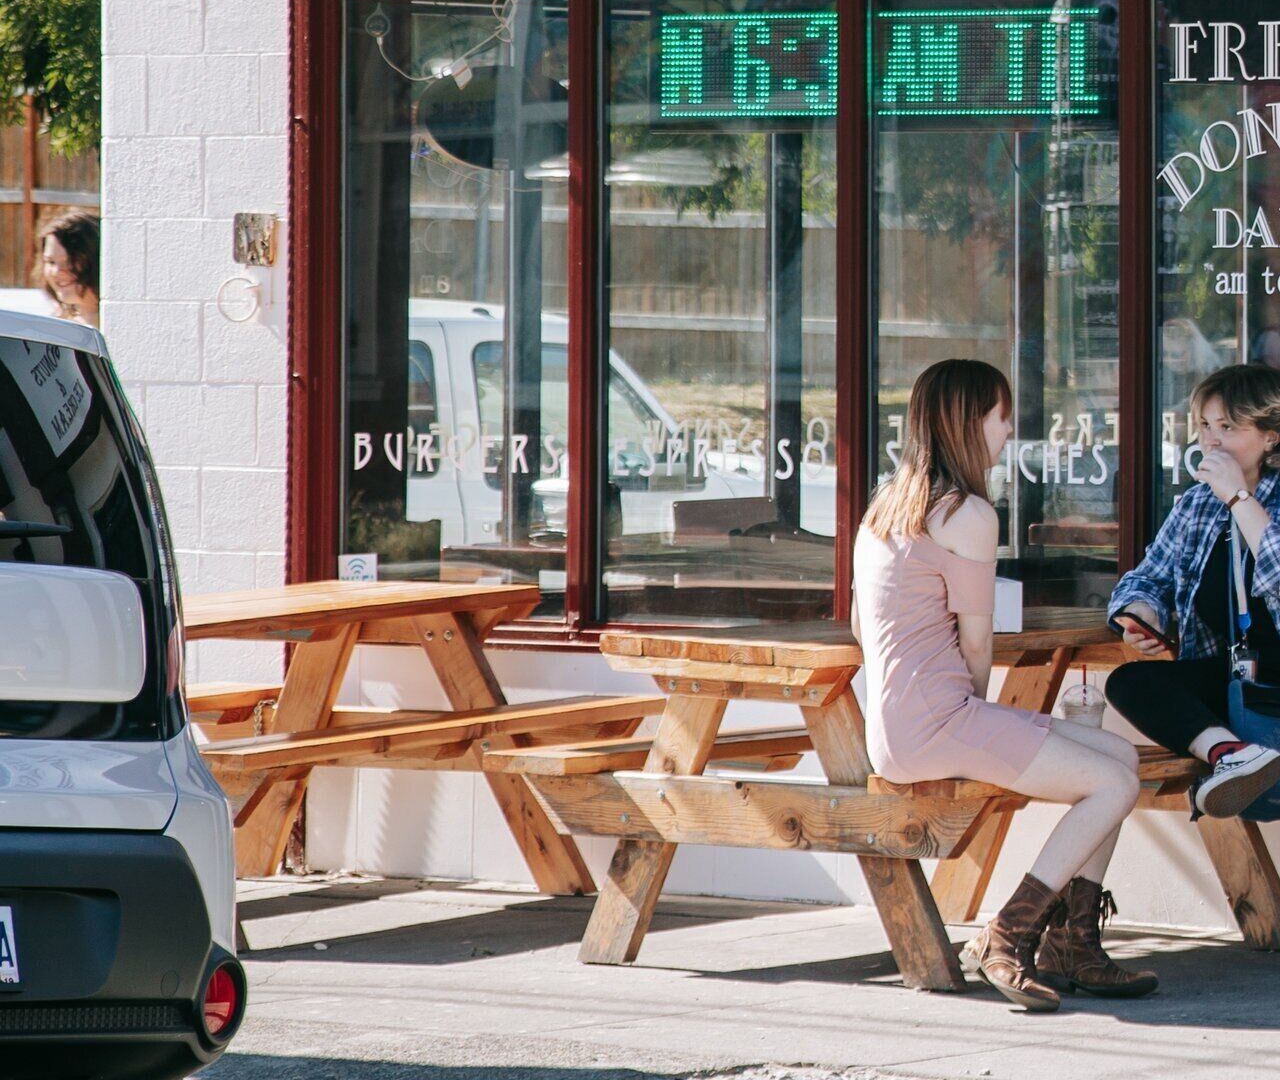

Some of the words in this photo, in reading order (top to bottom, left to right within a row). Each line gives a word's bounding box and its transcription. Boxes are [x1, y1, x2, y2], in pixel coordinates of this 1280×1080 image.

[1215, 271, 1248, 295] am
[353, 432, 563, 474] BURGERS
[612, 437, 827, 480] ESPRESSO
